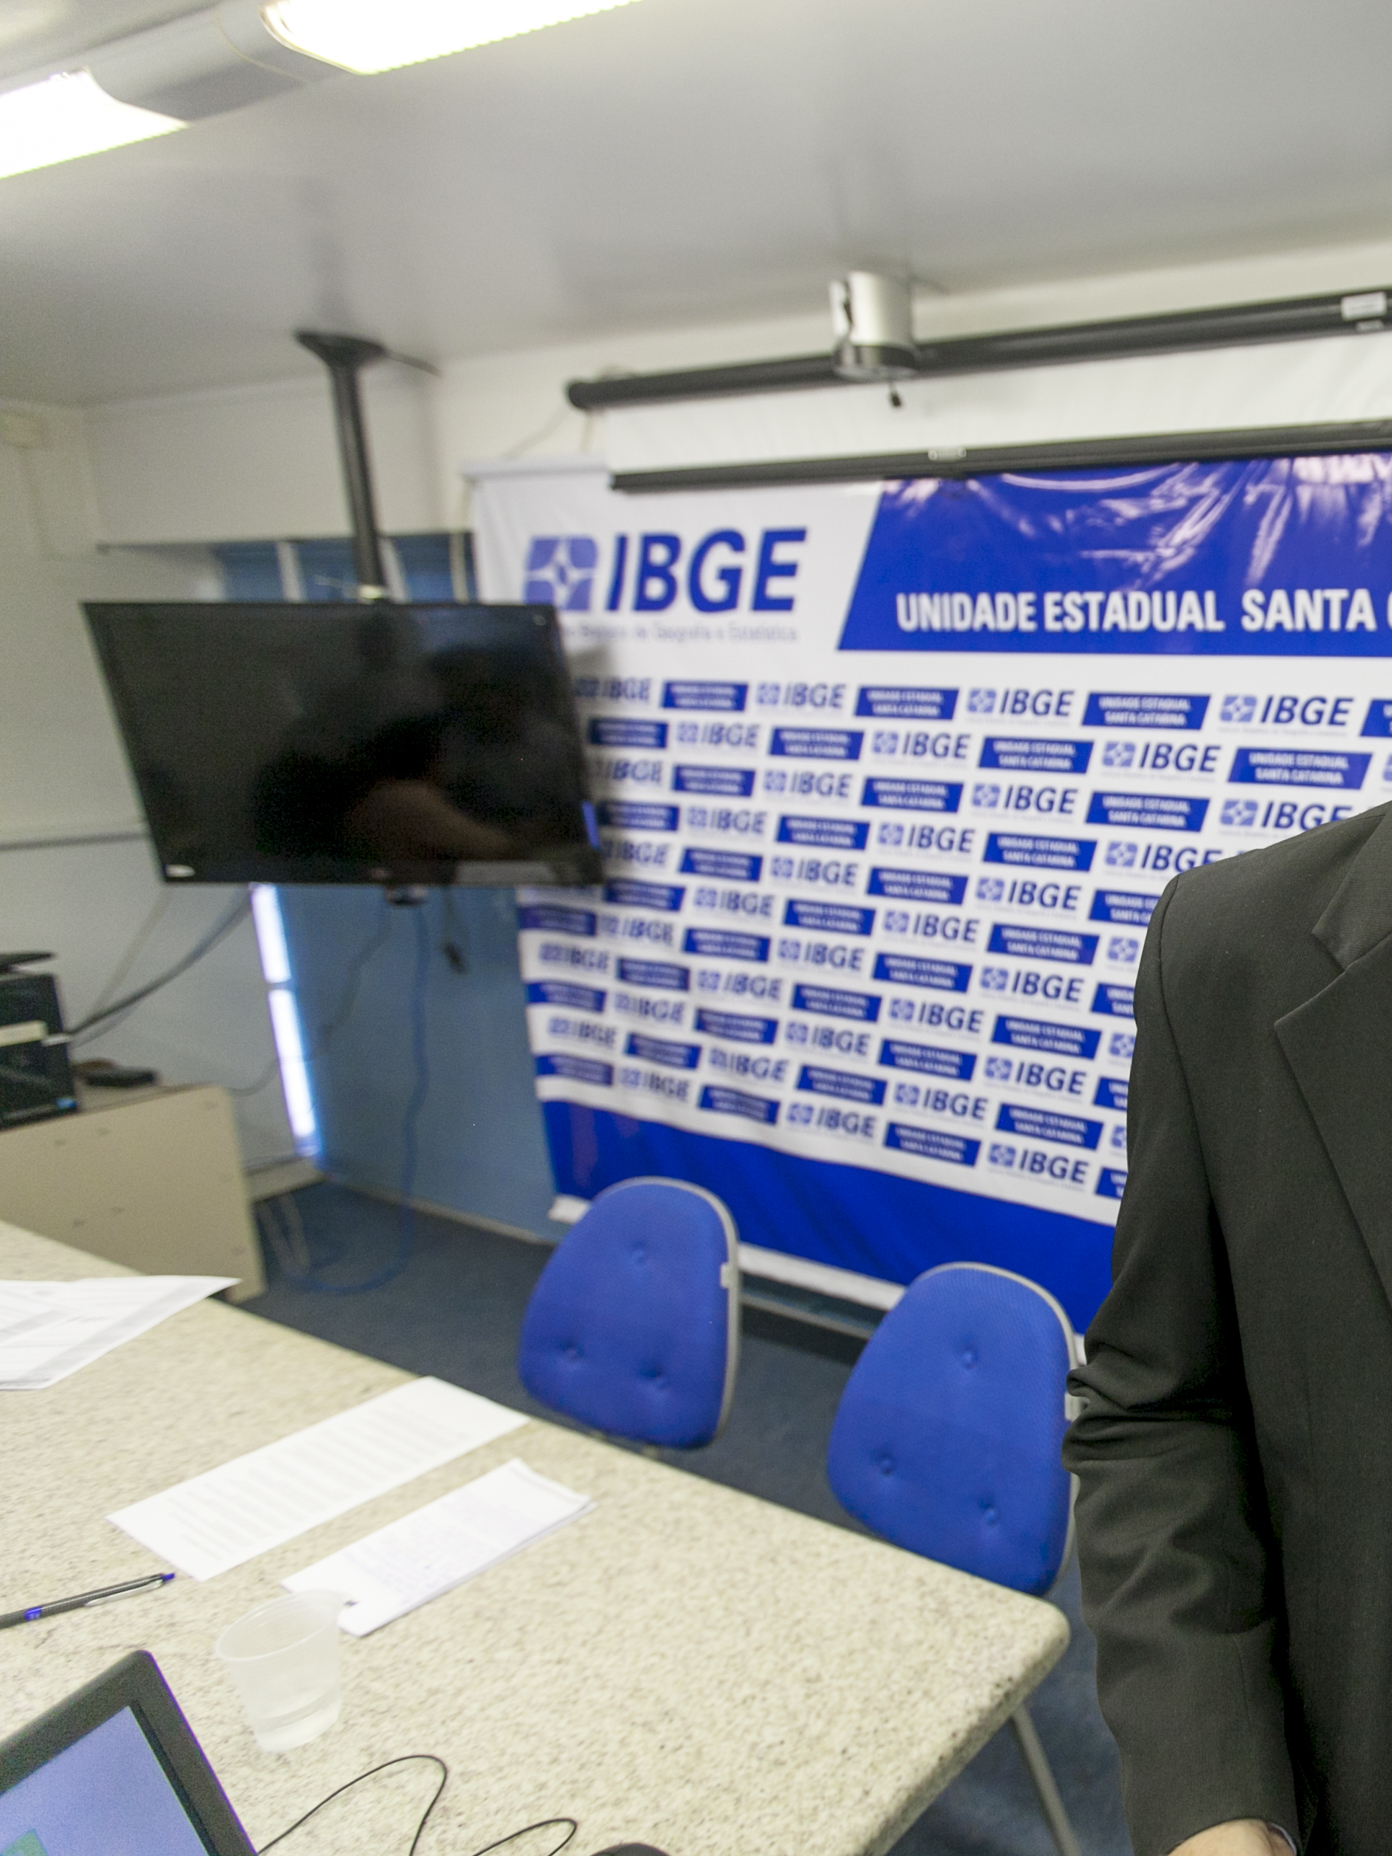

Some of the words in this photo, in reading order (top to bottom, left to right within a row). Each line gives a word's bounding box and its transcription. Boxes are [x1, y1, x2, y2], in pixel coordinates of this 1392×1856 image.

[604, 527, 807, 613] IBGE
[897, 592, 1036, 632] UNIDADE
[1044, 591, 1226, 632] ESTADUAL
[1241, 589, 1377, 632] SANTA
[783, 683, 845, 708] IBGE
[1000, 690, 1074, 716] IBGE
[1260, 696, 1354, 726] IBGE
[903, 733, 971, 758] IBGE
[1139, 742, 1221, 772] IBGE
[1004, 785, 1077, 814] IBGE
[908, 825, 975, 853] IBGE
[1008, 880, 1081, 910] IBGE
[913, 914, 979, 943] IBGE
[1012, 970, 1084, 1002] IBGE
[918, 1003, 983, 1033] IBGE
[1016, 1061, 1087, 1095] IBGE
[923, 1088, 988, 1120] IBGE
[1019, 1149, 1089, 1185] IBGE
